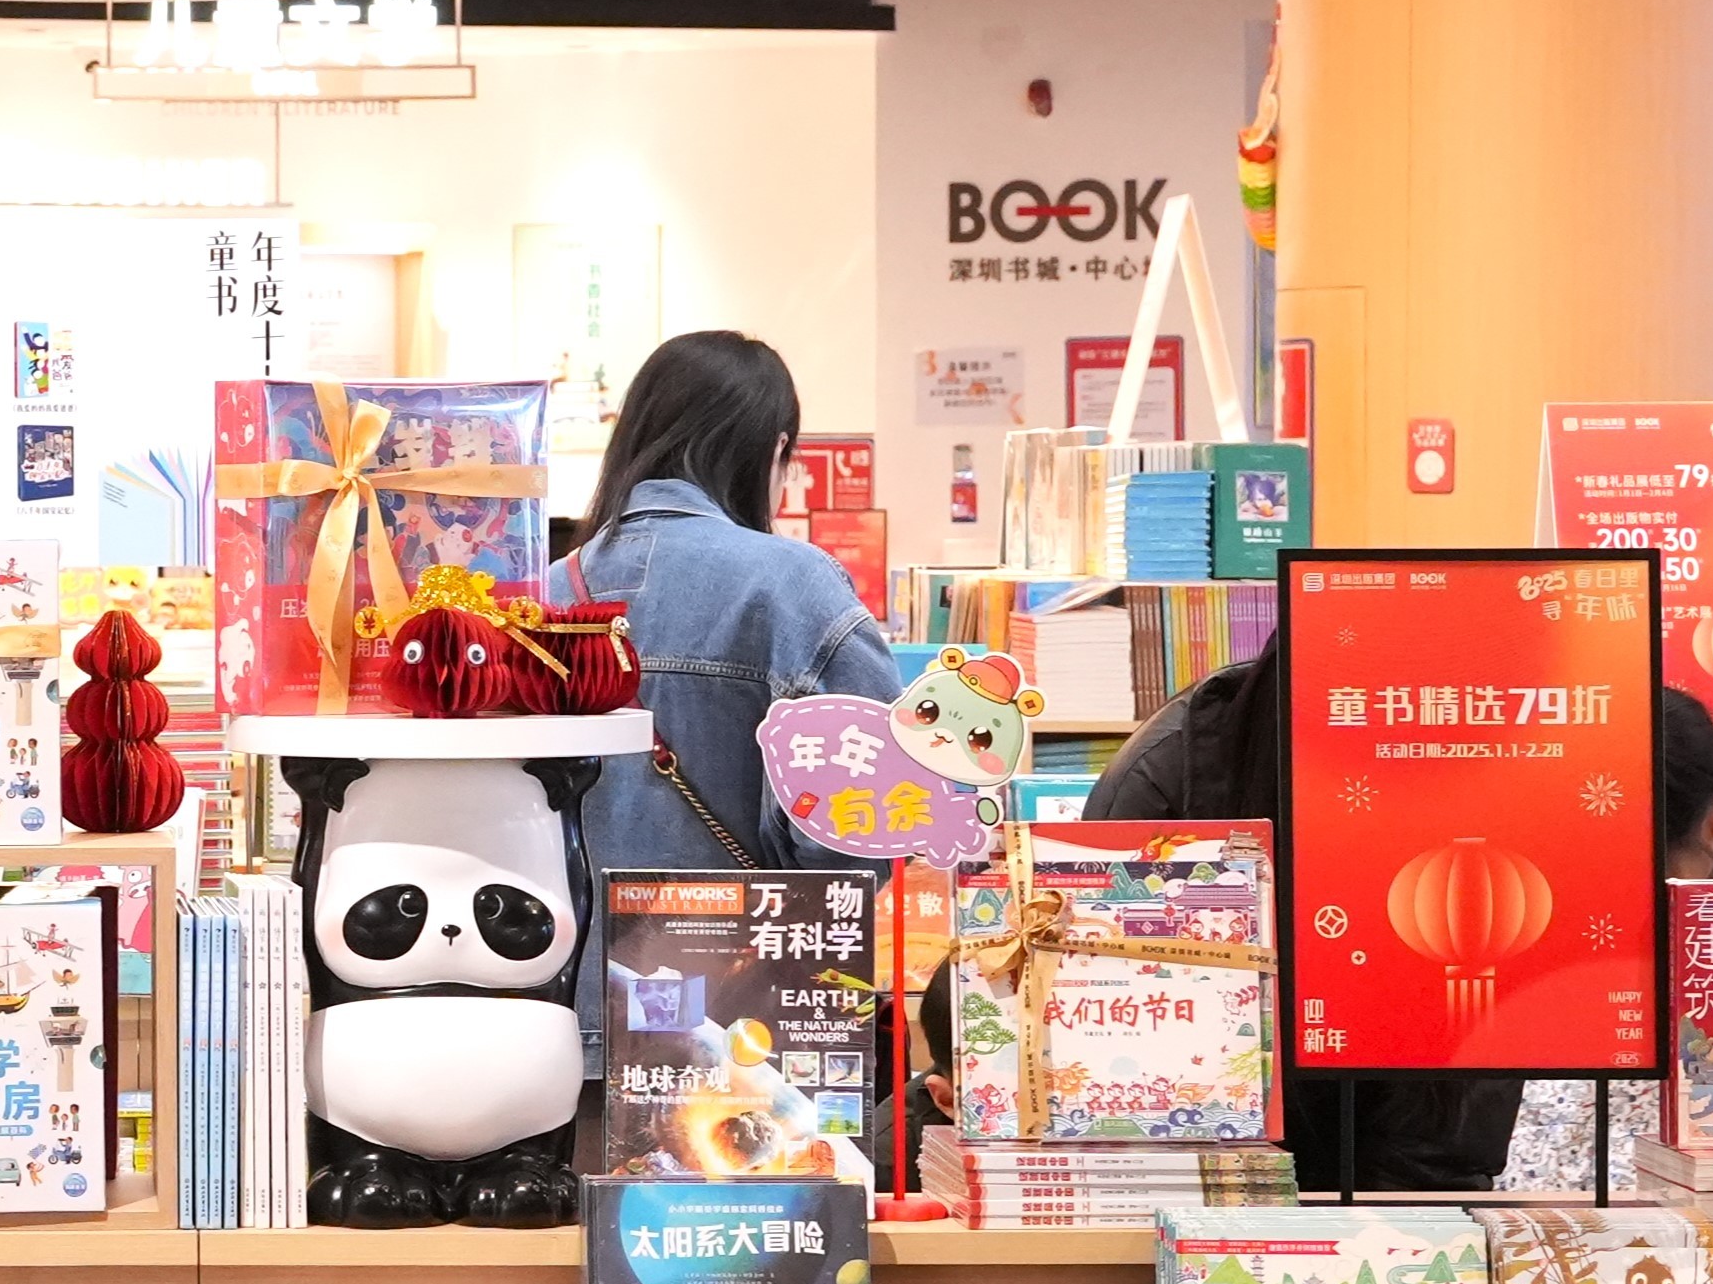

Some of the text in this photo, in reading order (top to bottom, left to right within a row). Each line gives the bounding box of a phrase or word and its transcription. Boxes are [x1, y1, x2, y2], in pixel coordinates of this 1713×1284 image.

[948, 179, 1168, 243] BOOK
[1410, 571, 1447, 585] BOOK
[1327, 684, 1610, 729] 童书精选79折
[787, 725, 884, 781] 年年
[827, 780, 934, 838] 有余
[617, 886, 738, 901] HOW IT WORKS
[749, 921, 864, 961] 有科学
[781, 989, 859, 1007] EARTH
[1608, 990, 1644, 1005] HAPPY
[1303, 998, 1326, 1024] 迎
[1619, 1008, 1644, 1022] NEW
[778, 1020, 862, 1032] THE NATURAL
[789, 1032, 850, 1043] WONDERS
[1615, 1027, 1644, 1041] YEAR
[1303, 1026, 1348, 1054] 新年
[621, 1065, 732, 1093] 地球奇观
[629, 1219, 826, 1260] 太阳系大冒险
